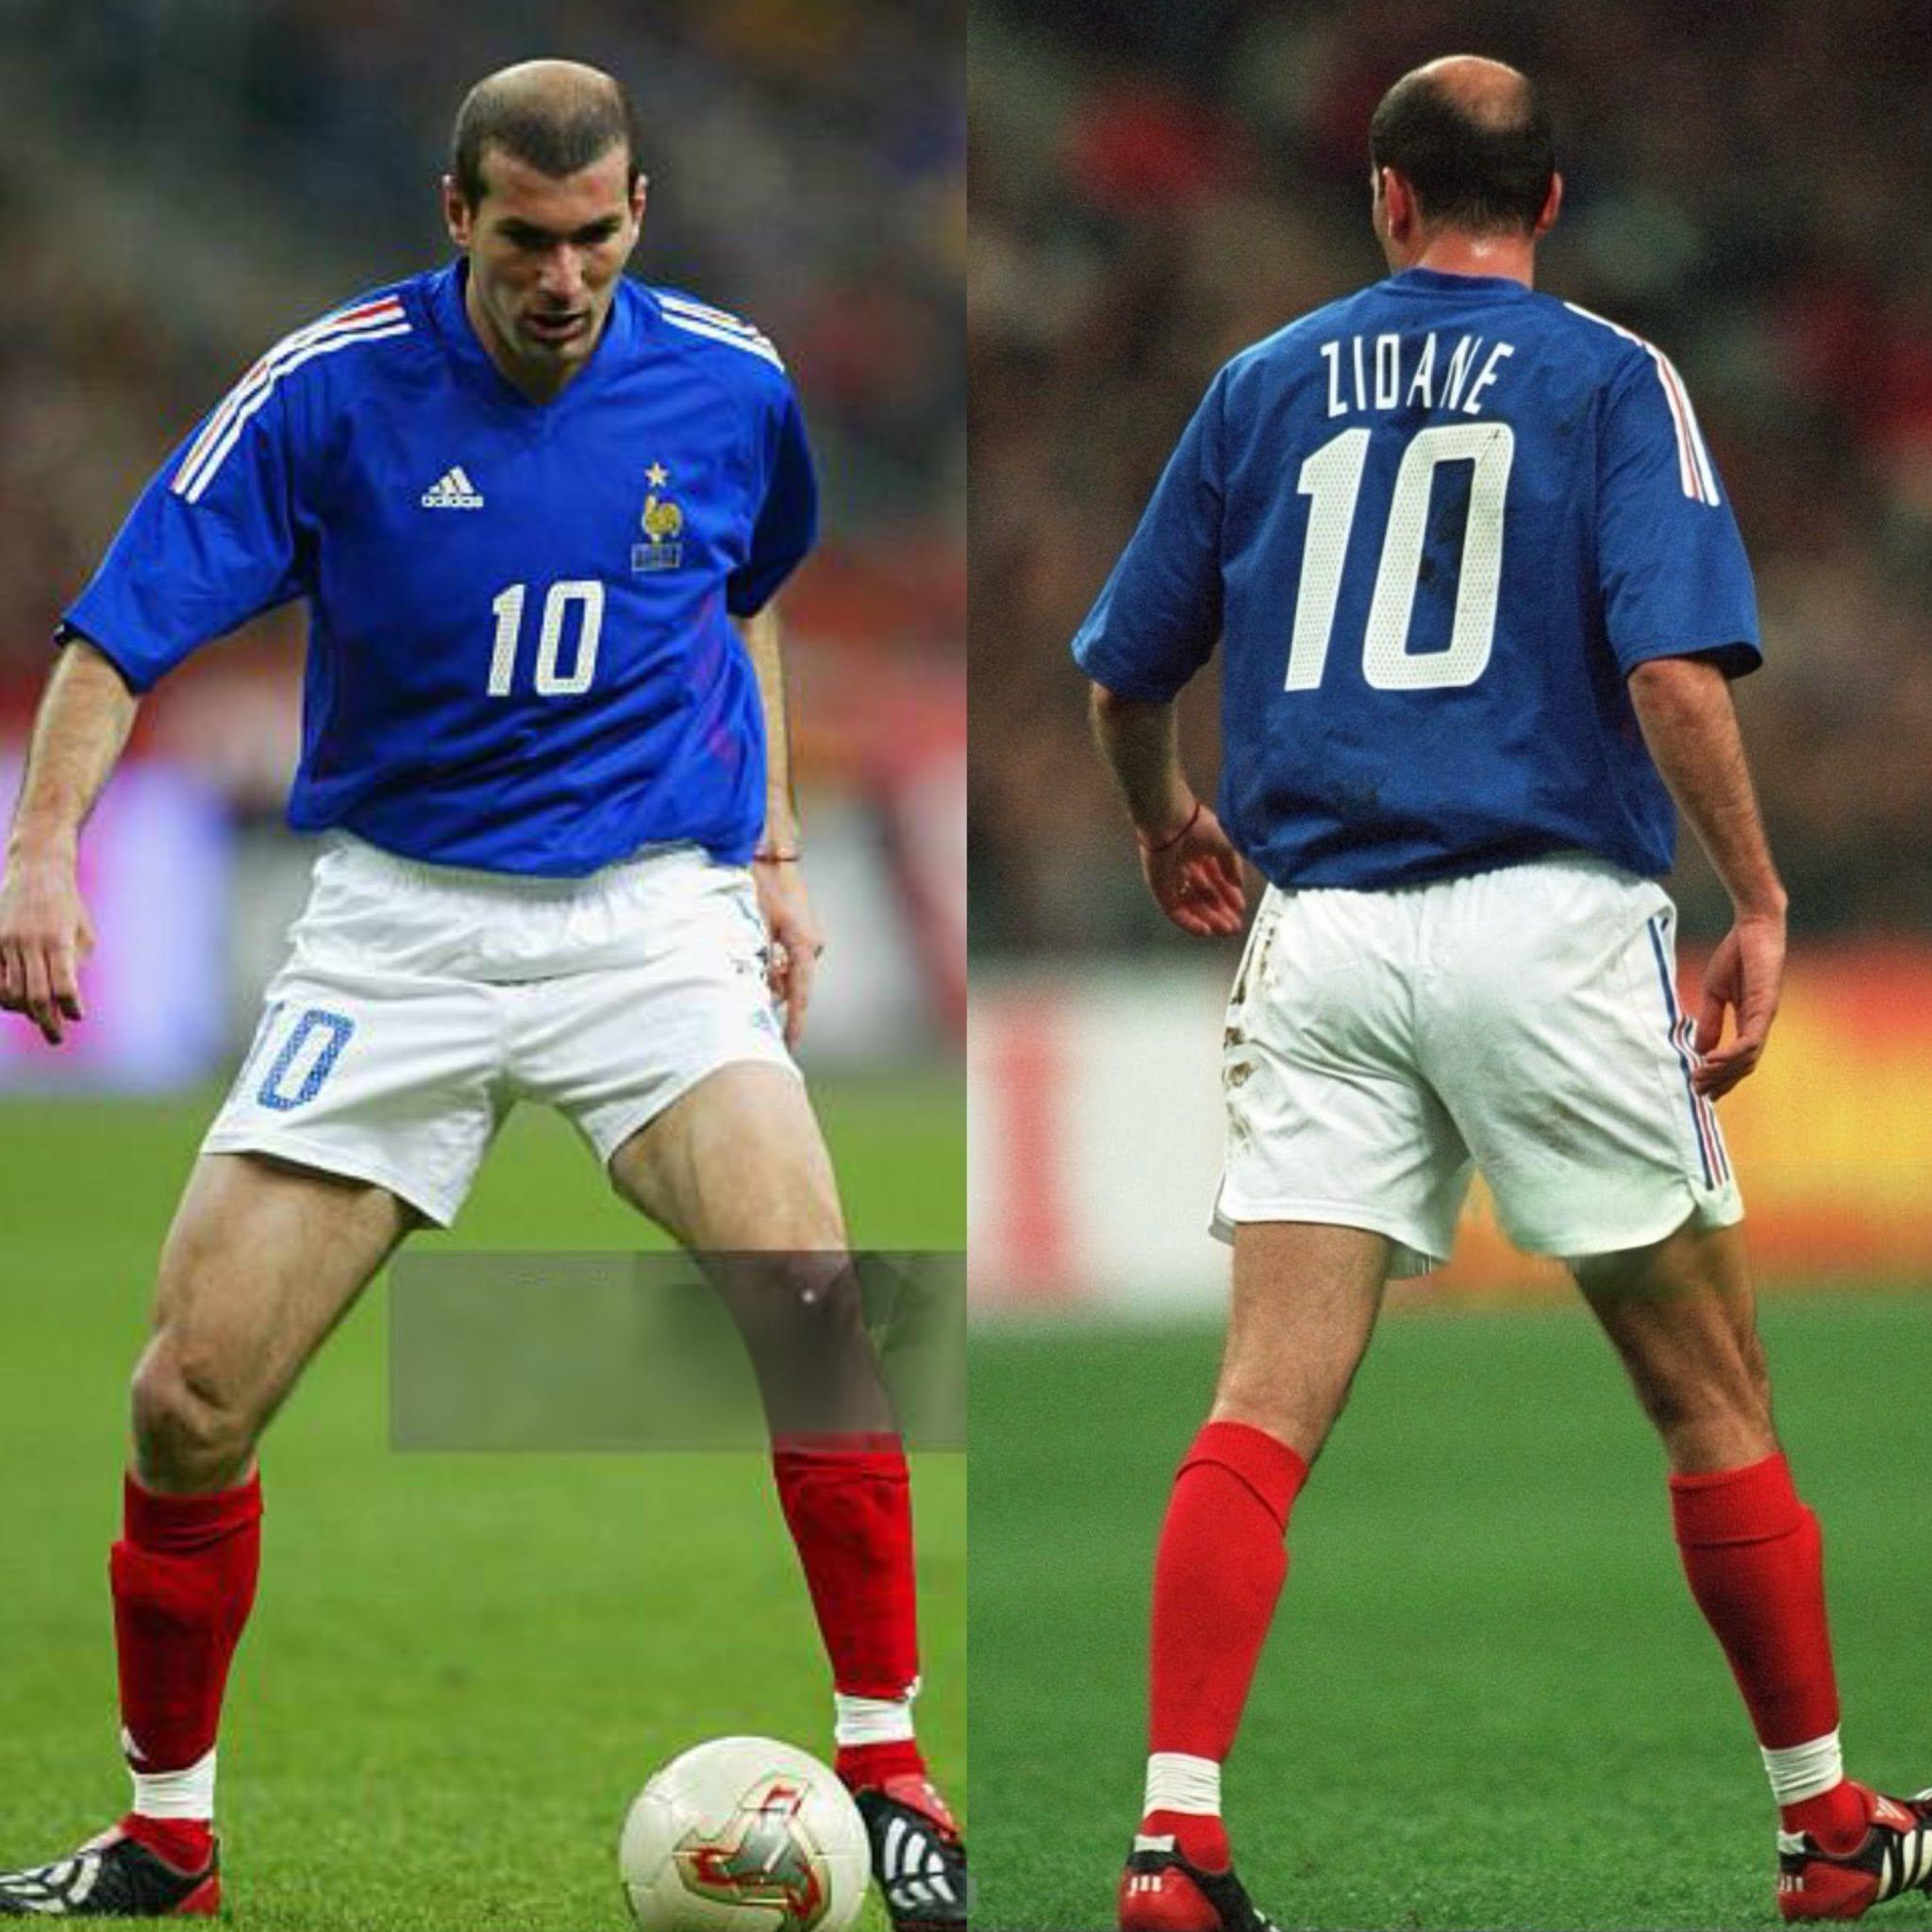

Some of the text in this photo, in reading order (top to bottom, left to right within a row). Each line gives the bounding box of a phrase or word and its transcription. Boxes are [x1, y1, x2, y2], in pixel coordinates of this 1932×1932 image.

[1321, 332, 1515, 418] ZIDANE
[1284, 422, 1515, 691] 10
[487, 579, 605, 696] 10
